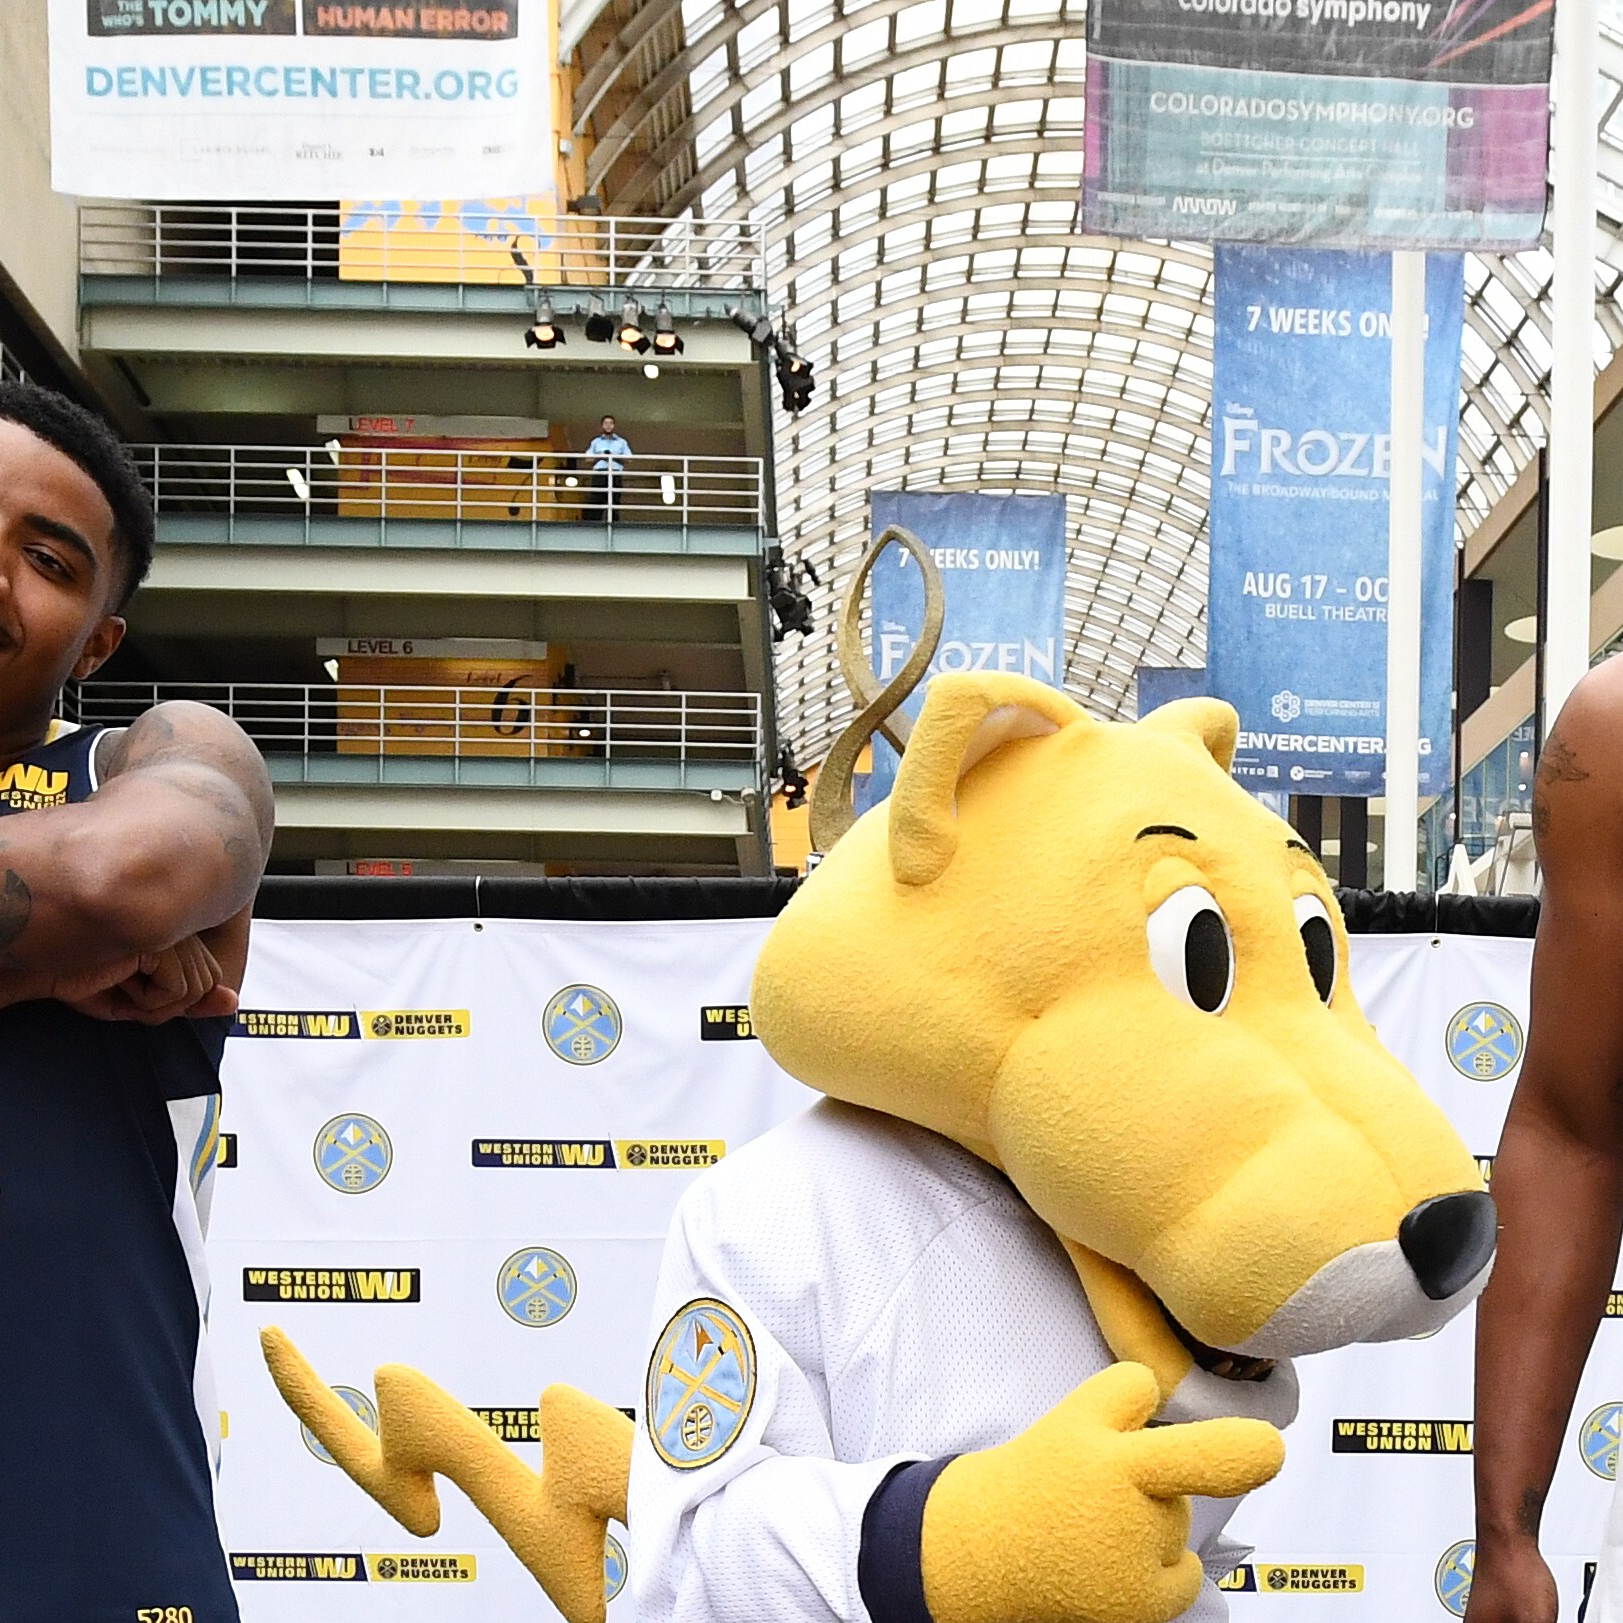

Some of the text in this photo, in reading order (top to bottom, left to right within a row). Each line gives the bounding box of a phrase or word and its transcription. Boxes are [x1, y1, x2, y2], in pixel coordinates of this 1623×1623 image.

[148, 0, 268, 27] TOMMY
[317, 6, 509, 33] HUMAN ERROR
[85, 65, 519, 100] DENVERCENTER.ORG
[1150, 91, 1475, 129] COLORADOSYMPHONY.ORG
[1247, 305, 1429, 341] 7 WEEKS ON!
[348, 417, 415, 432] LEVEL 7
[1228, 481, 1249, 496] THE
[898, 547, 1040, 571] 7 EEKS ONLY!
[1243, 571, 1292, 599] AUG
[1301, 574, 1327, 600] 17
[1355, 576, 1390, 603] OC
[1265, 604, 1389, 623] BUELL THEATR
[348, 639, 413, 655] LEVEL 6
[346, 861, 397, 876] LEVEL
[239, 1013, 299, 1024] ESTERN
[394, 1015, 453, 1024] DENVER
[248, 1024, 299, 1035] UNION
[307, 1015, 351, 1037] WU
[394, 1024, 463, 1035] NUGGETS
[479, 1142, 553, 1154] WESTERN
[562, 1144, 604, 1166] WU
[649, 1144, 708, 1154] DENVER
[502, 1154, 553, 1165] UNION
[649, 1154, 719, 1165] NUGGETS
[248, 1271, 346, 1285] WESTERN
[279, 1285, 346, 1299] UNION
[356, 1272, 411, 1300] WU
[479, 1411, 540, 1425] ESTER
[1338, 1422, 1432, 1436] WESTERN
[1366, 1436, 1432, 1450] UNION
[233, 1556, 307, 1567] WESTERN
[317, 1557, 357, 1579] WU
[400, 1558, 457, 1568] DENVER
[256, 1567, 307, 1578] UNION
[400, 1568, 469, 1579] NUGGETS
[1291, 1569, 1347, 1578] DENVER
[1291, 1579, 1357, 1589] NUGGETS
